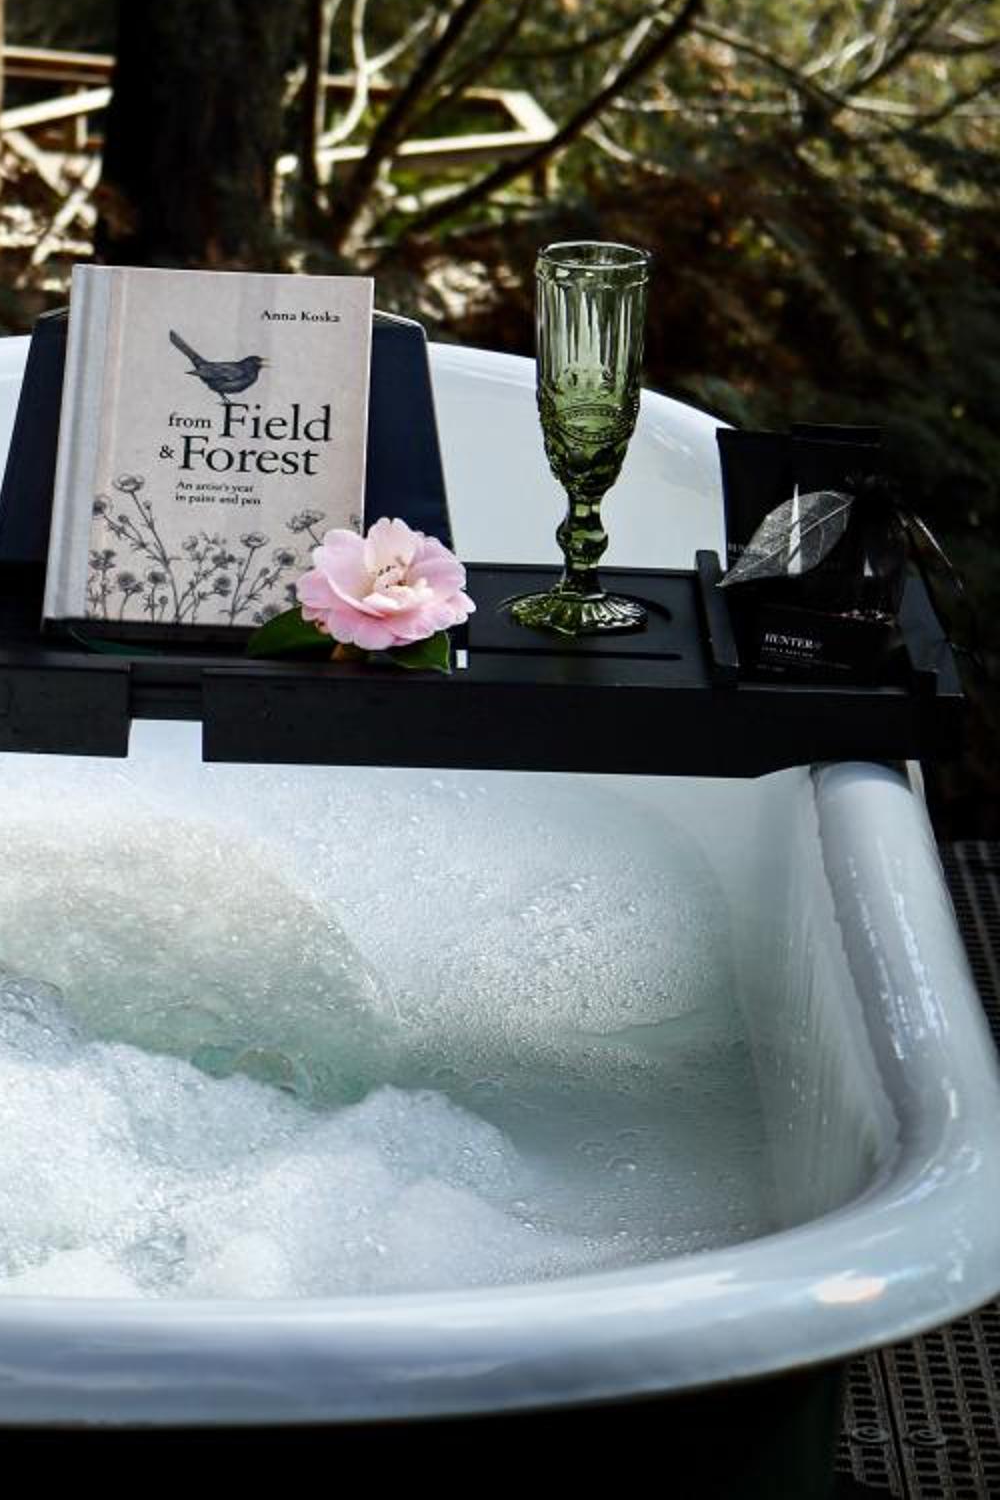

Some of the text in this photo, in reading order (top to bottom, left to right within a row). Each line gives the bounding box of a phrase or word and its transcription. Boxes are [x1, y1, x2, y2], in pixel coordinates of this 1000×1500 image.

[261, 310, 340, 323] Anna Koska
[168, 403, 332, 442] from Field
[159, 435, 320, 475] & Forest
[176, 480, 193, 490] An
[231, 485, 254, 494] year
[175, 492, 187, 501] in
[219, 494, 239, 504] and
[241, 497, 261, 506] pen
